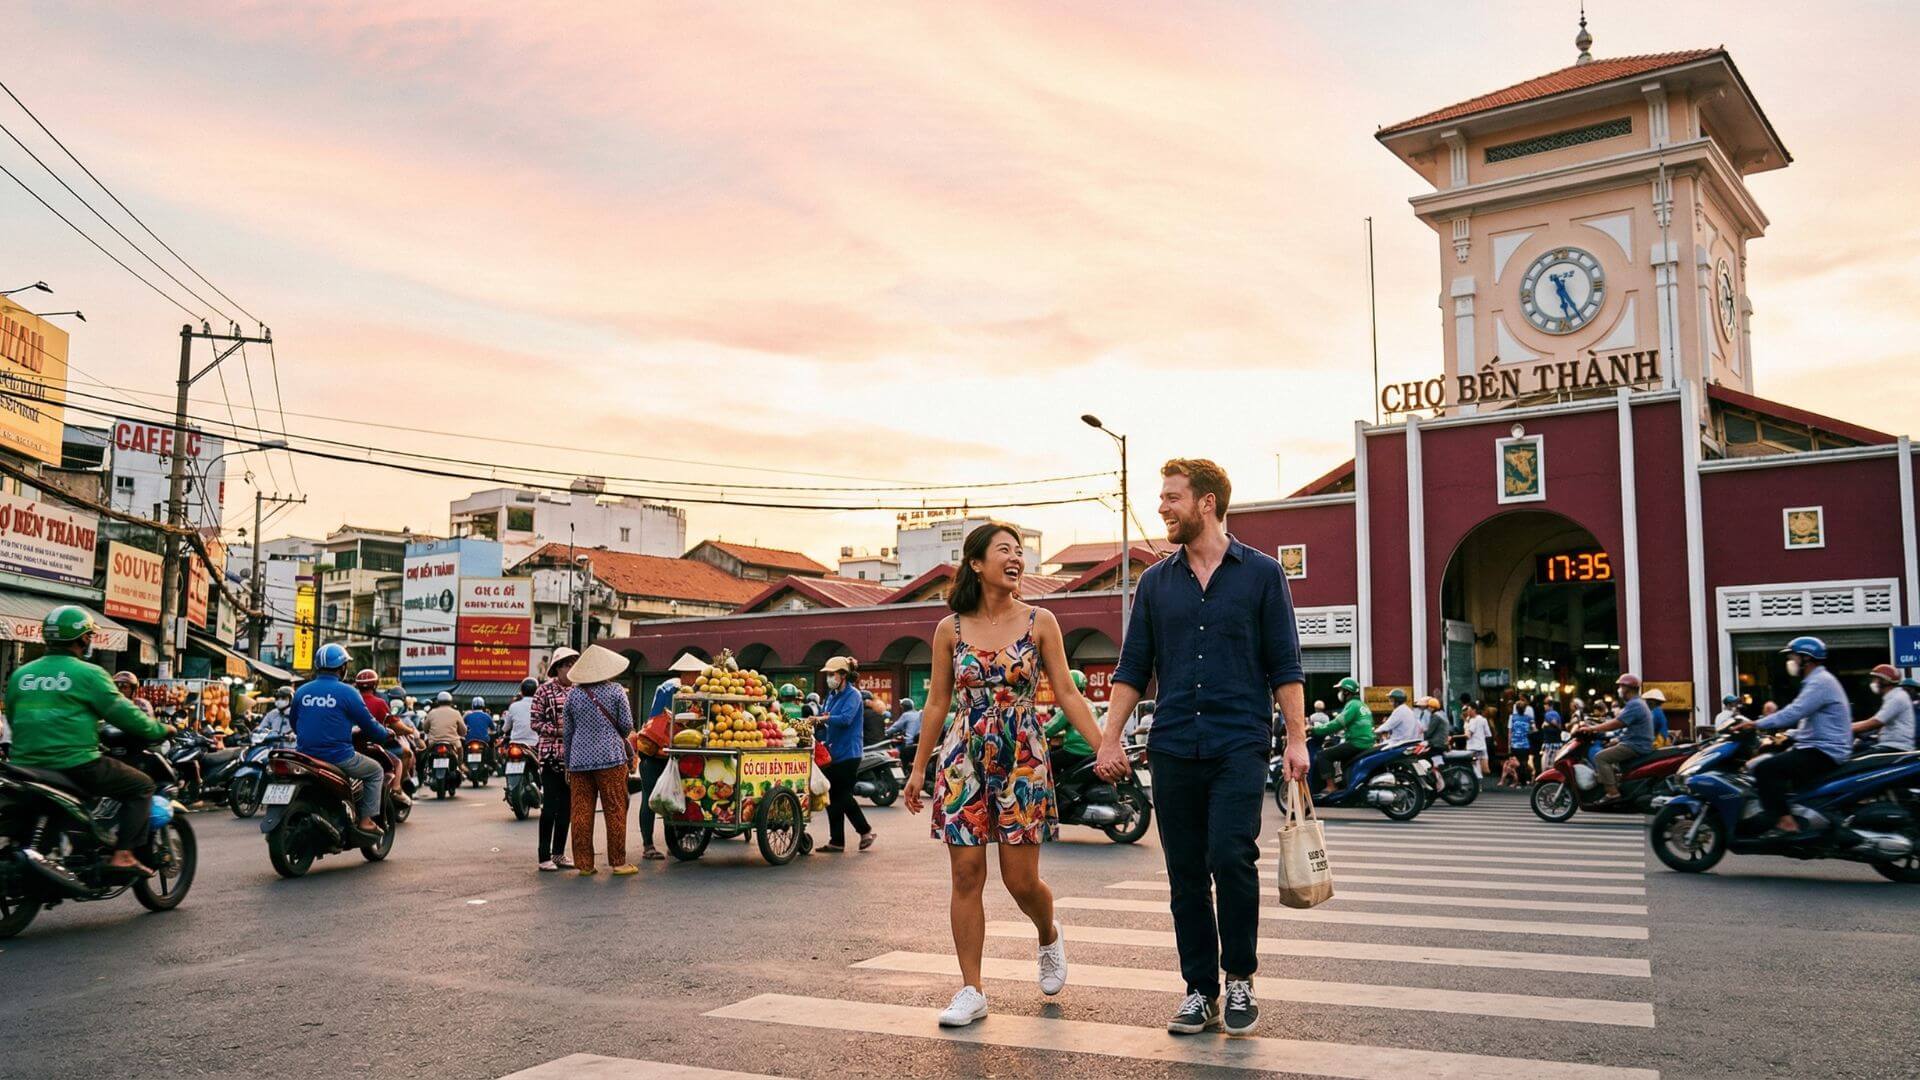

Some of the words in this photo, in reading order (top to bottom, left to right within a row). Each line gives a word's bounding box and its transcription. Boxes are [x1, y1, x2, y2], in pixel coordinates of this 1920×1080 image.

[1382, 374, 1446, 414] CHỢ
[1456, 355, 1521, 404] BẾN
[1533, 350, 1661, 392] THÀNH
[13, 503, 44, 538] BẾN
[46, 515, 96, 552] THÀNH
[1548, 552, 1611, 581] 17:35
[18, 671, 73, 691] Grab
[301, 693, 337, 708] Grab
